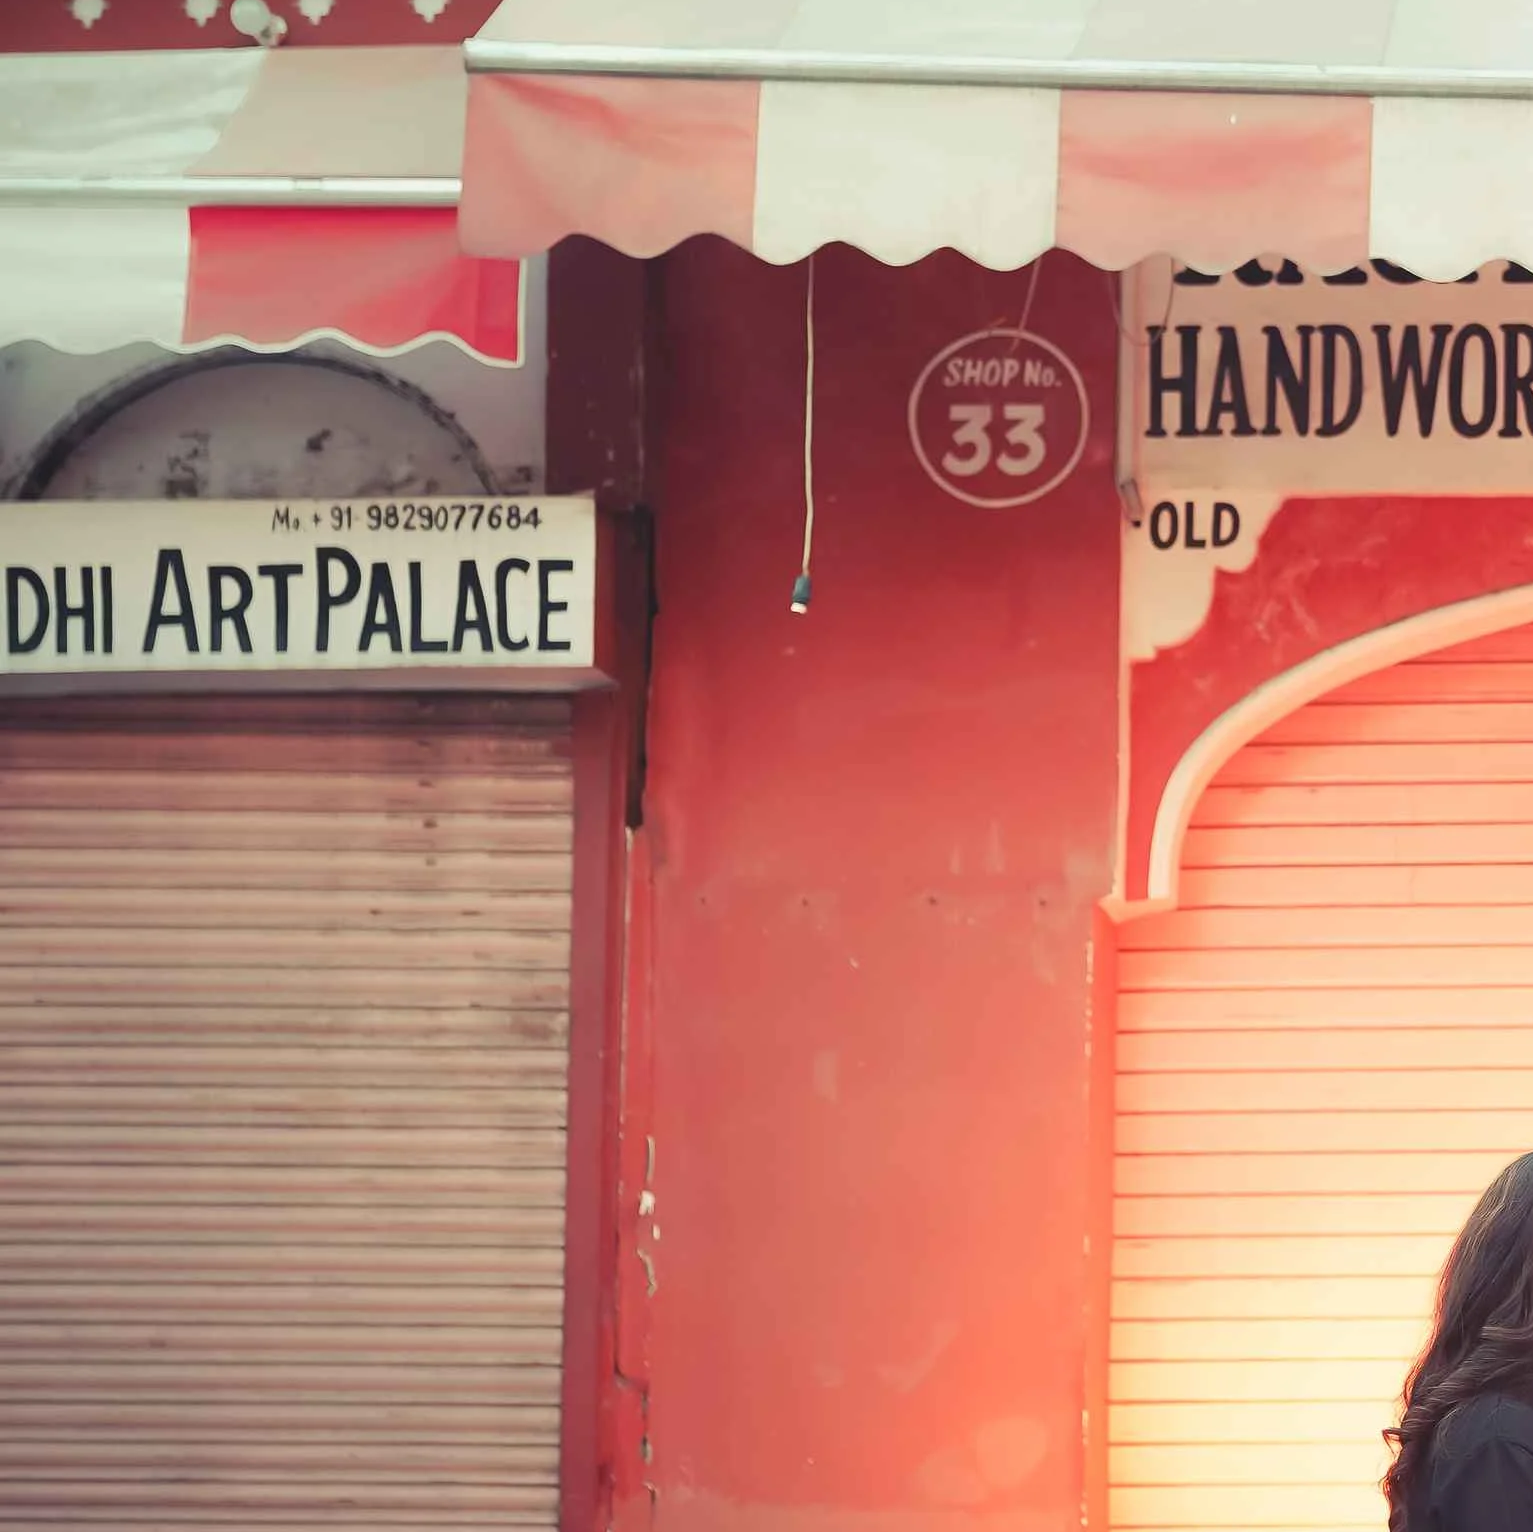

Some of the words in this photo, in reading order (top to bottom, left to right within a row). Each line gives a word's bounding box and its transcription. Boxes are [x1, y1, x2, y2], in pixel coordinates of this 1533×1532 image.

[943, 356, 1021, 388] SHOP
[1024, 358, 1063, 388] No.
[941, 404, 1046, 477] 33
[366, 504, 542, 531] 9829077684
[1149, 501, 1241, 549] OLD
[7, 566, 114, 655] DHI
[142, 548, 303, 655] ART
[315, 547, 574, 653] PALACE
